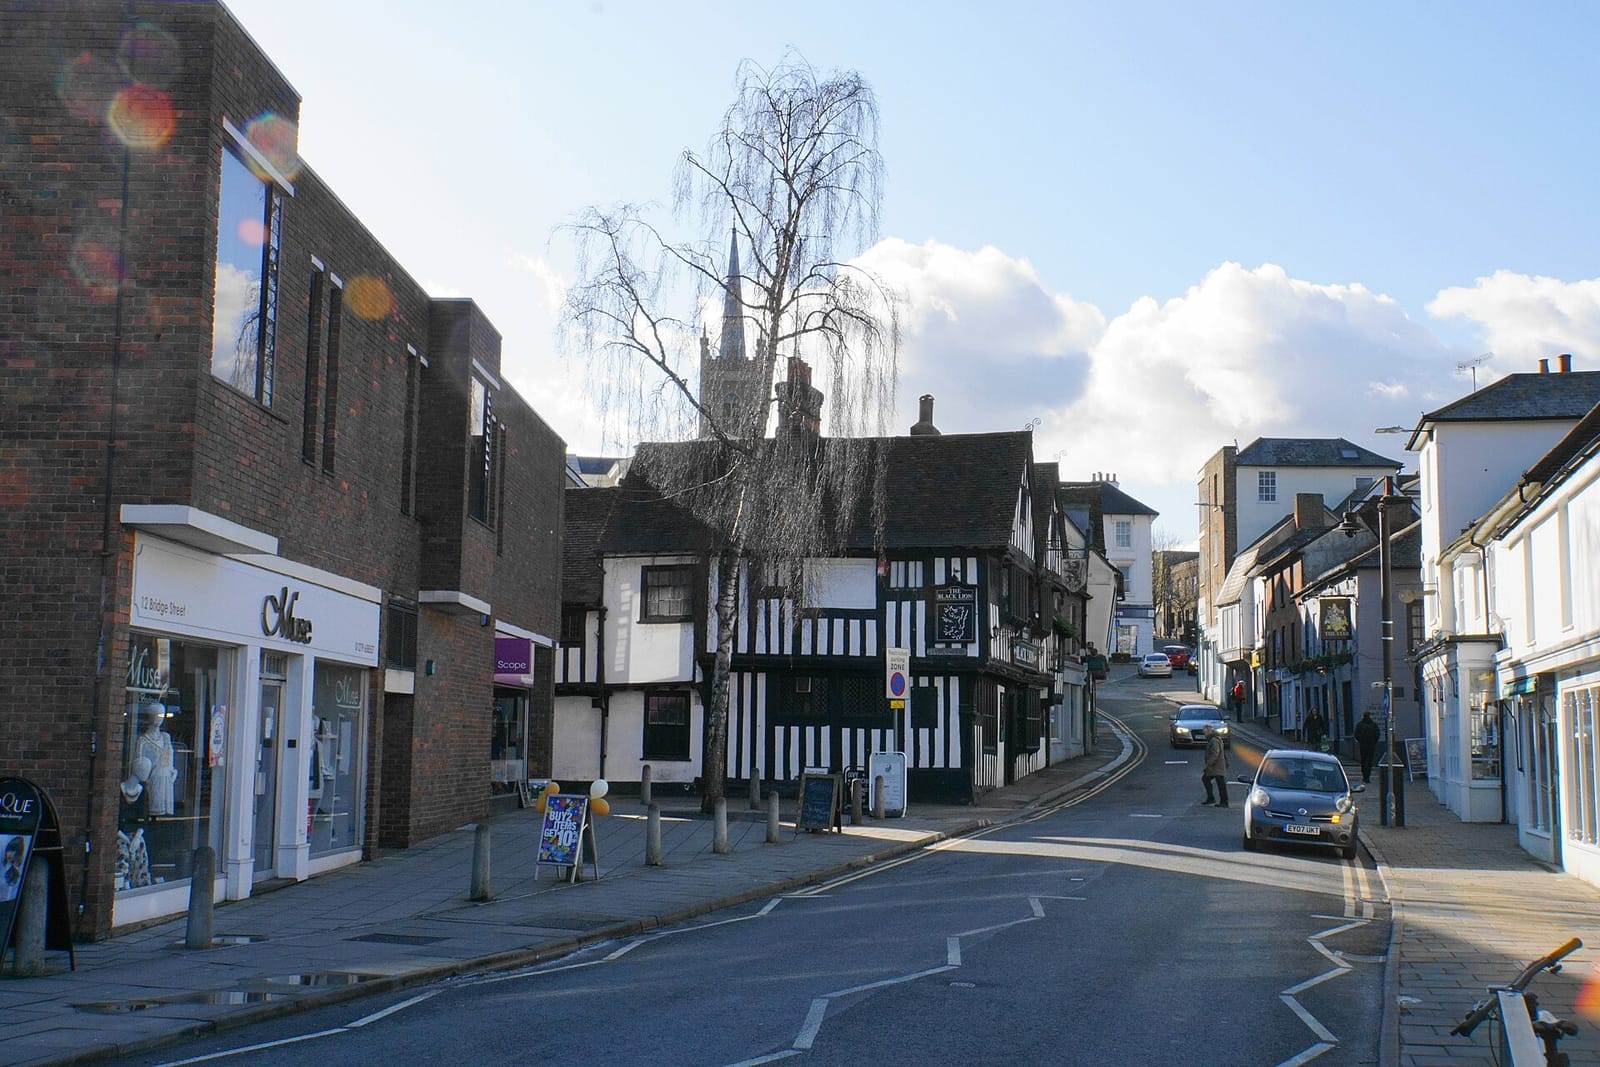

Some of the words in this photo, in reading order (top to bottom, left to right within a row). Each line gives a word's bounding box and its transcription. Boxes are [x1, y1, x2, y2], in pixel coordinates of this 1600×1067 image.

[141, 596, 149, 610] 12
[150, 598, 168, 616] Bridge
[169, 601, 187, 617] Street
[261, 586, 312, 644] Muse
[127, 645, 161, 688] Muse
[497, 660, 527, 670] Scope
[890, 663, 905, 671] ZONE
[335, 674, 361, 705] Muse
[0, 792, 34, 813] QUE
[549, 810, 567, 821] BUY
[566, 812, 573, 821] 2
[544, 828, 558, 838] GET
[553, 821, 577, 832] ITEMS
